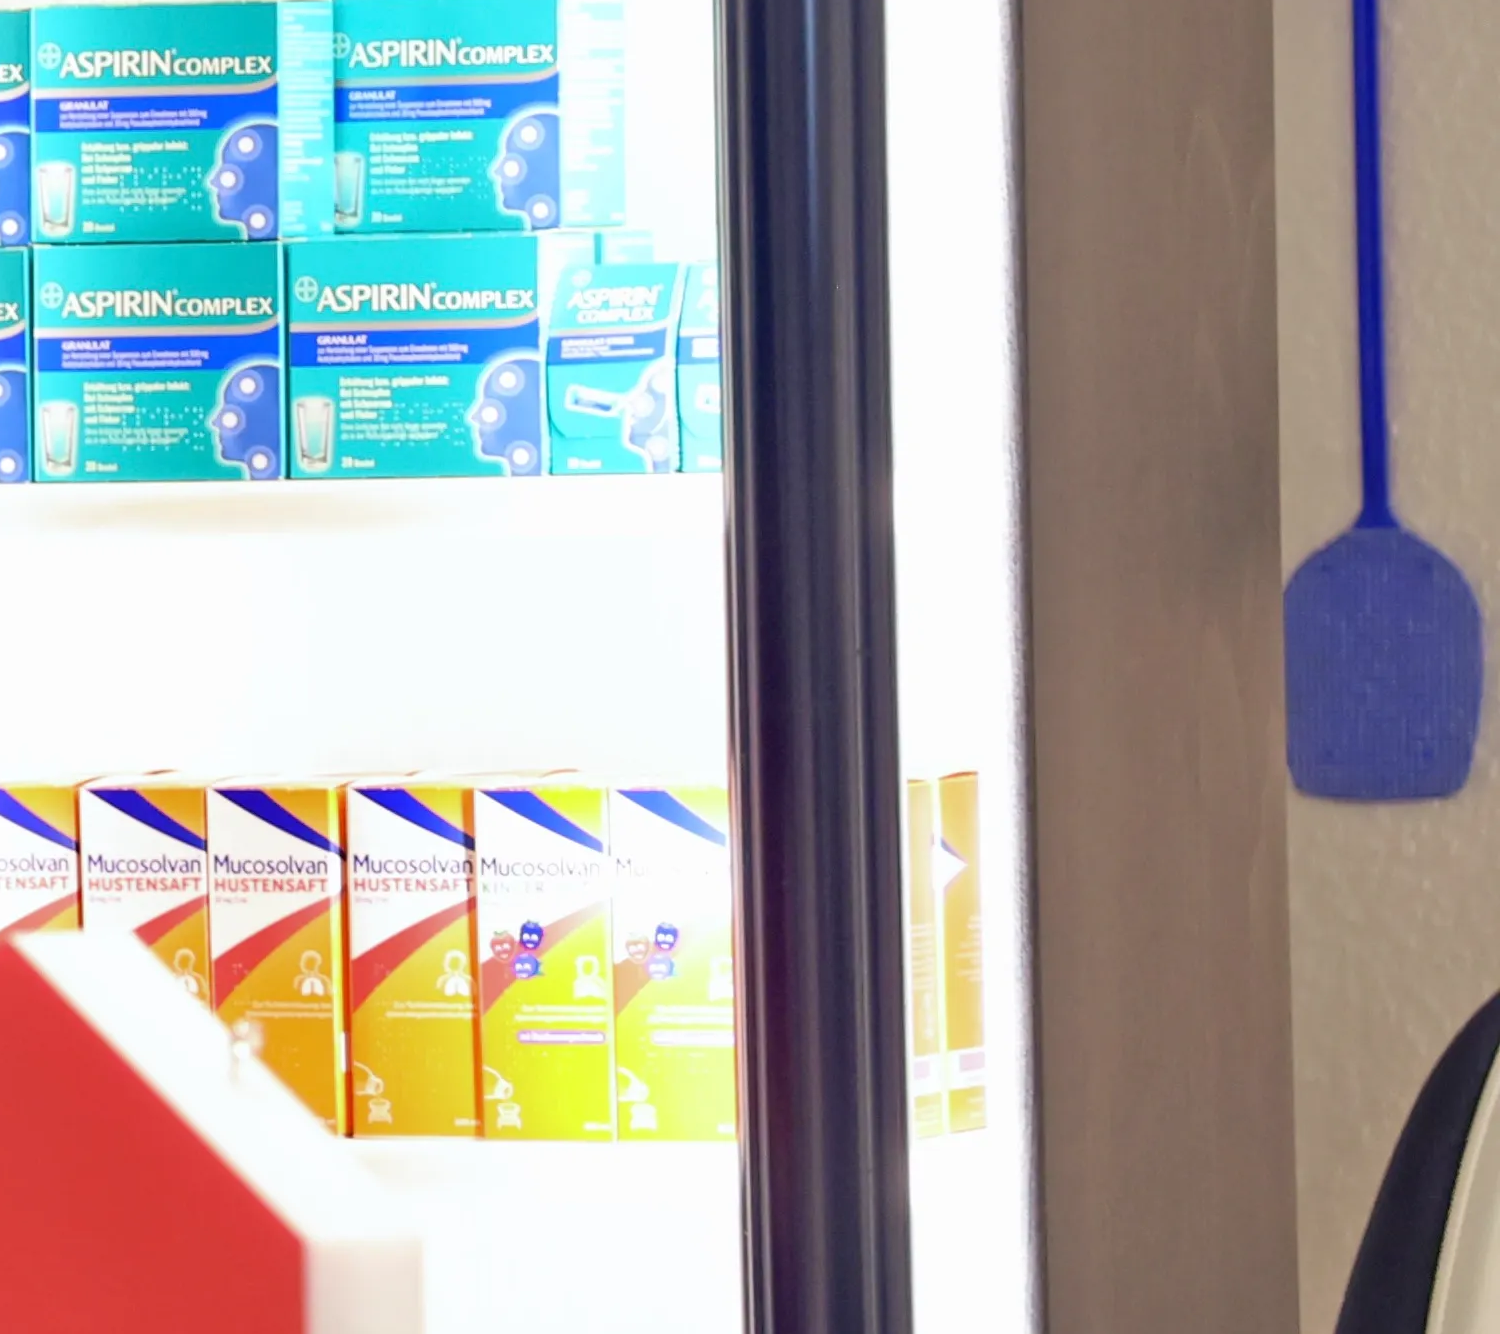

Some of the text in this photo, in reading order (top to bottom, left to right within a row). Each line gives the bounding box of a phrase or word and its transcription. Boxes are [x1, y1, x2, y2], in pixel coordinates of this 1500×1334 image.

[60, 49, 273, 79] ASPIRIN COMPLEX
[349, 38, 554, 69] ASPIRIN COMPLEX
[62, 289, 273, 319] ASPIRIN COMPLEX
[317, 283, 534, 313] ASPIRIN COMPLEX
[567, 286, 659, 310] ASPIRIN
[87, 854, 201, 875] Mucosolvan
[214, 854, 328, 875] Mucosolvan
[353, 854, 474, 875] Mucosolvan
[88, 877, 202, 893] HUSTENSAFT
[214, 877, 328, 893] HUSTENSAFT
[354, 877, 474, 893] HUSTENSAFT
